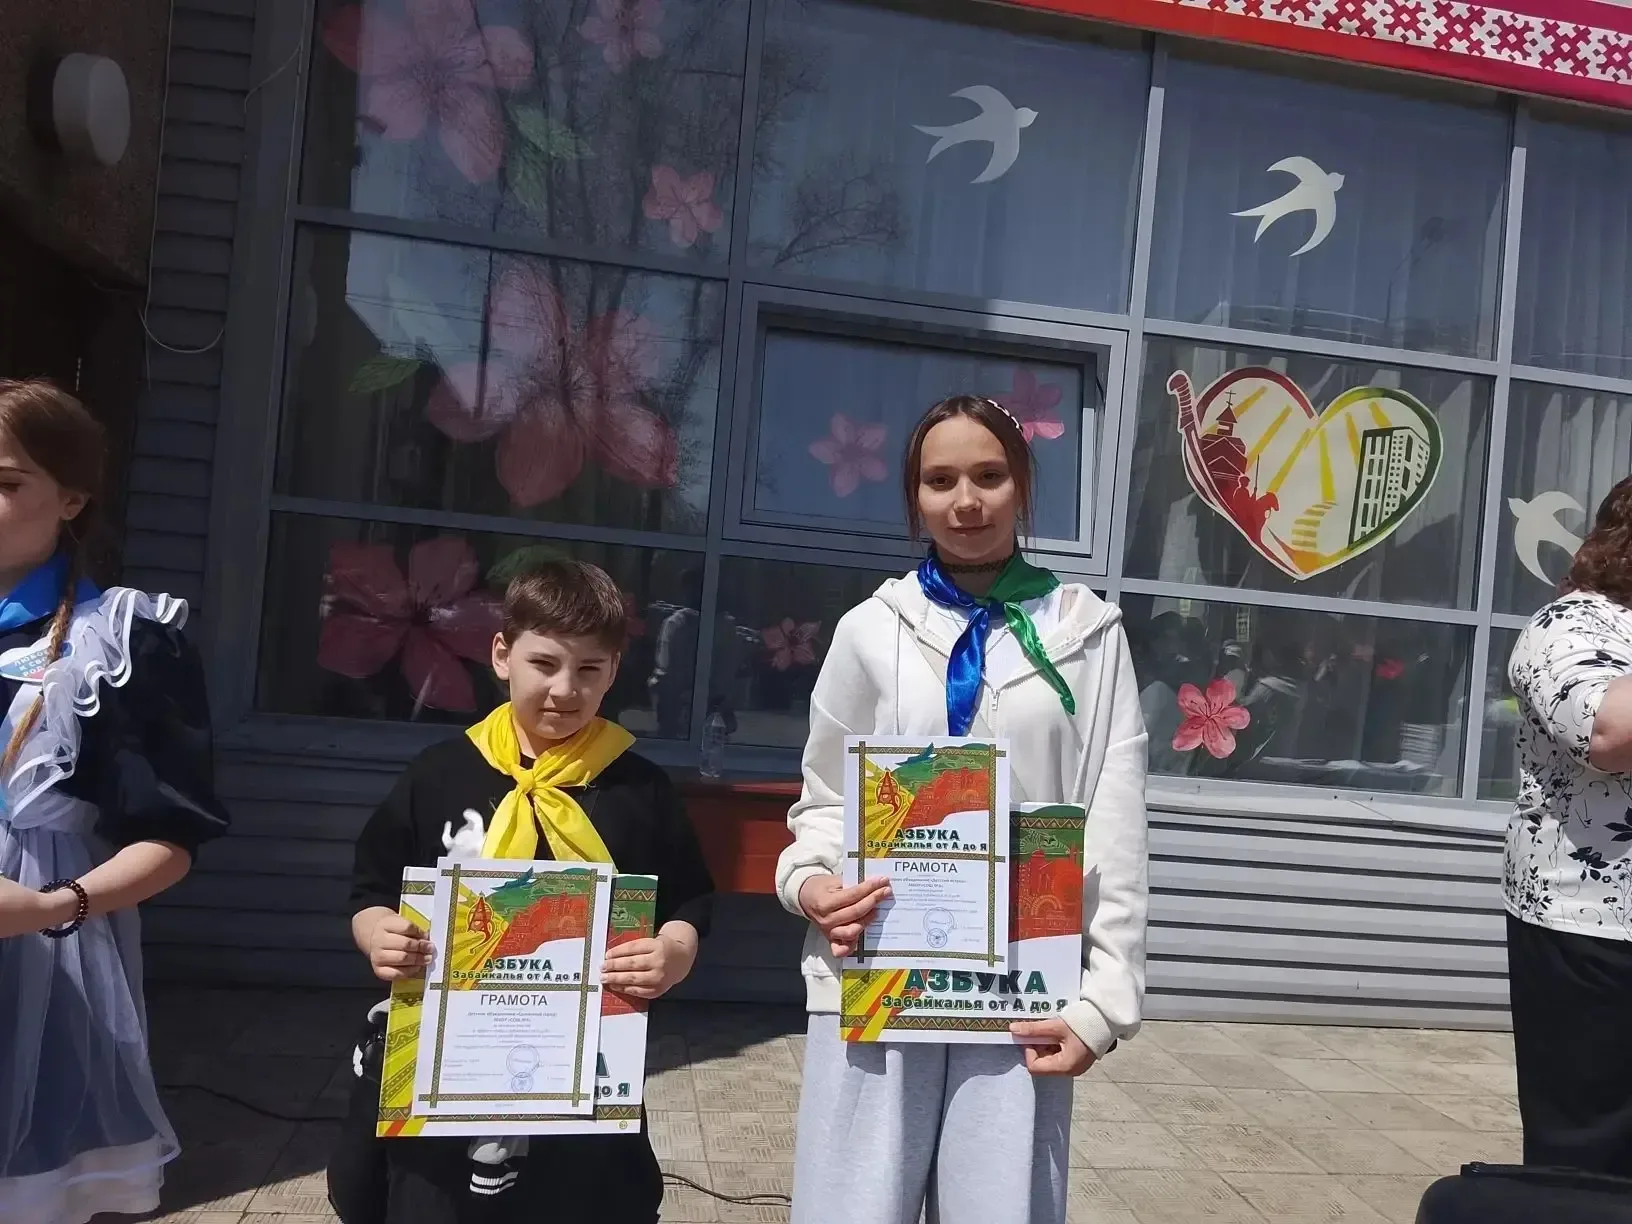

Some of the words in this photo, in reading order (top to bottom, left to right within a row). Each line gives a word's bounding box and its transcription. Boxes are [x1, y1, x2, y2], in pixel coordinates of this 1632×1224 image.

[894, 828, 960, 841] АЗБУКА
[867, 840, 932, 849] Забайкалья
[952, 841, 959, 850] А
[962, 843, 976, 851] до
[980, 842, 988, 851] Я
[894, 861, 958, 873] ГРАМОТА
[483, 958, 553, 971] АЗБУКА
[452, 970, 523, 981] Забайкалья
[527, 972, 540, 980] от
[543, 971, 551, 981] А
[555, 973, 569, 982] до
[573, 972, 581, 981] Я
[904, 969, 1048, 994] АЗБУКА
[480, 994, 548, 1006] ГРАМОТА
[881, 995, 983, 1010] Забайкалья
[988, 998, 1008, 1011] от
[1013, 997, 1025, 1012] А
[1030, 999, 1051, 1012] до
[1056, 998, 1068, 1012] Я
[616, 1083, 630, 1098] Я
